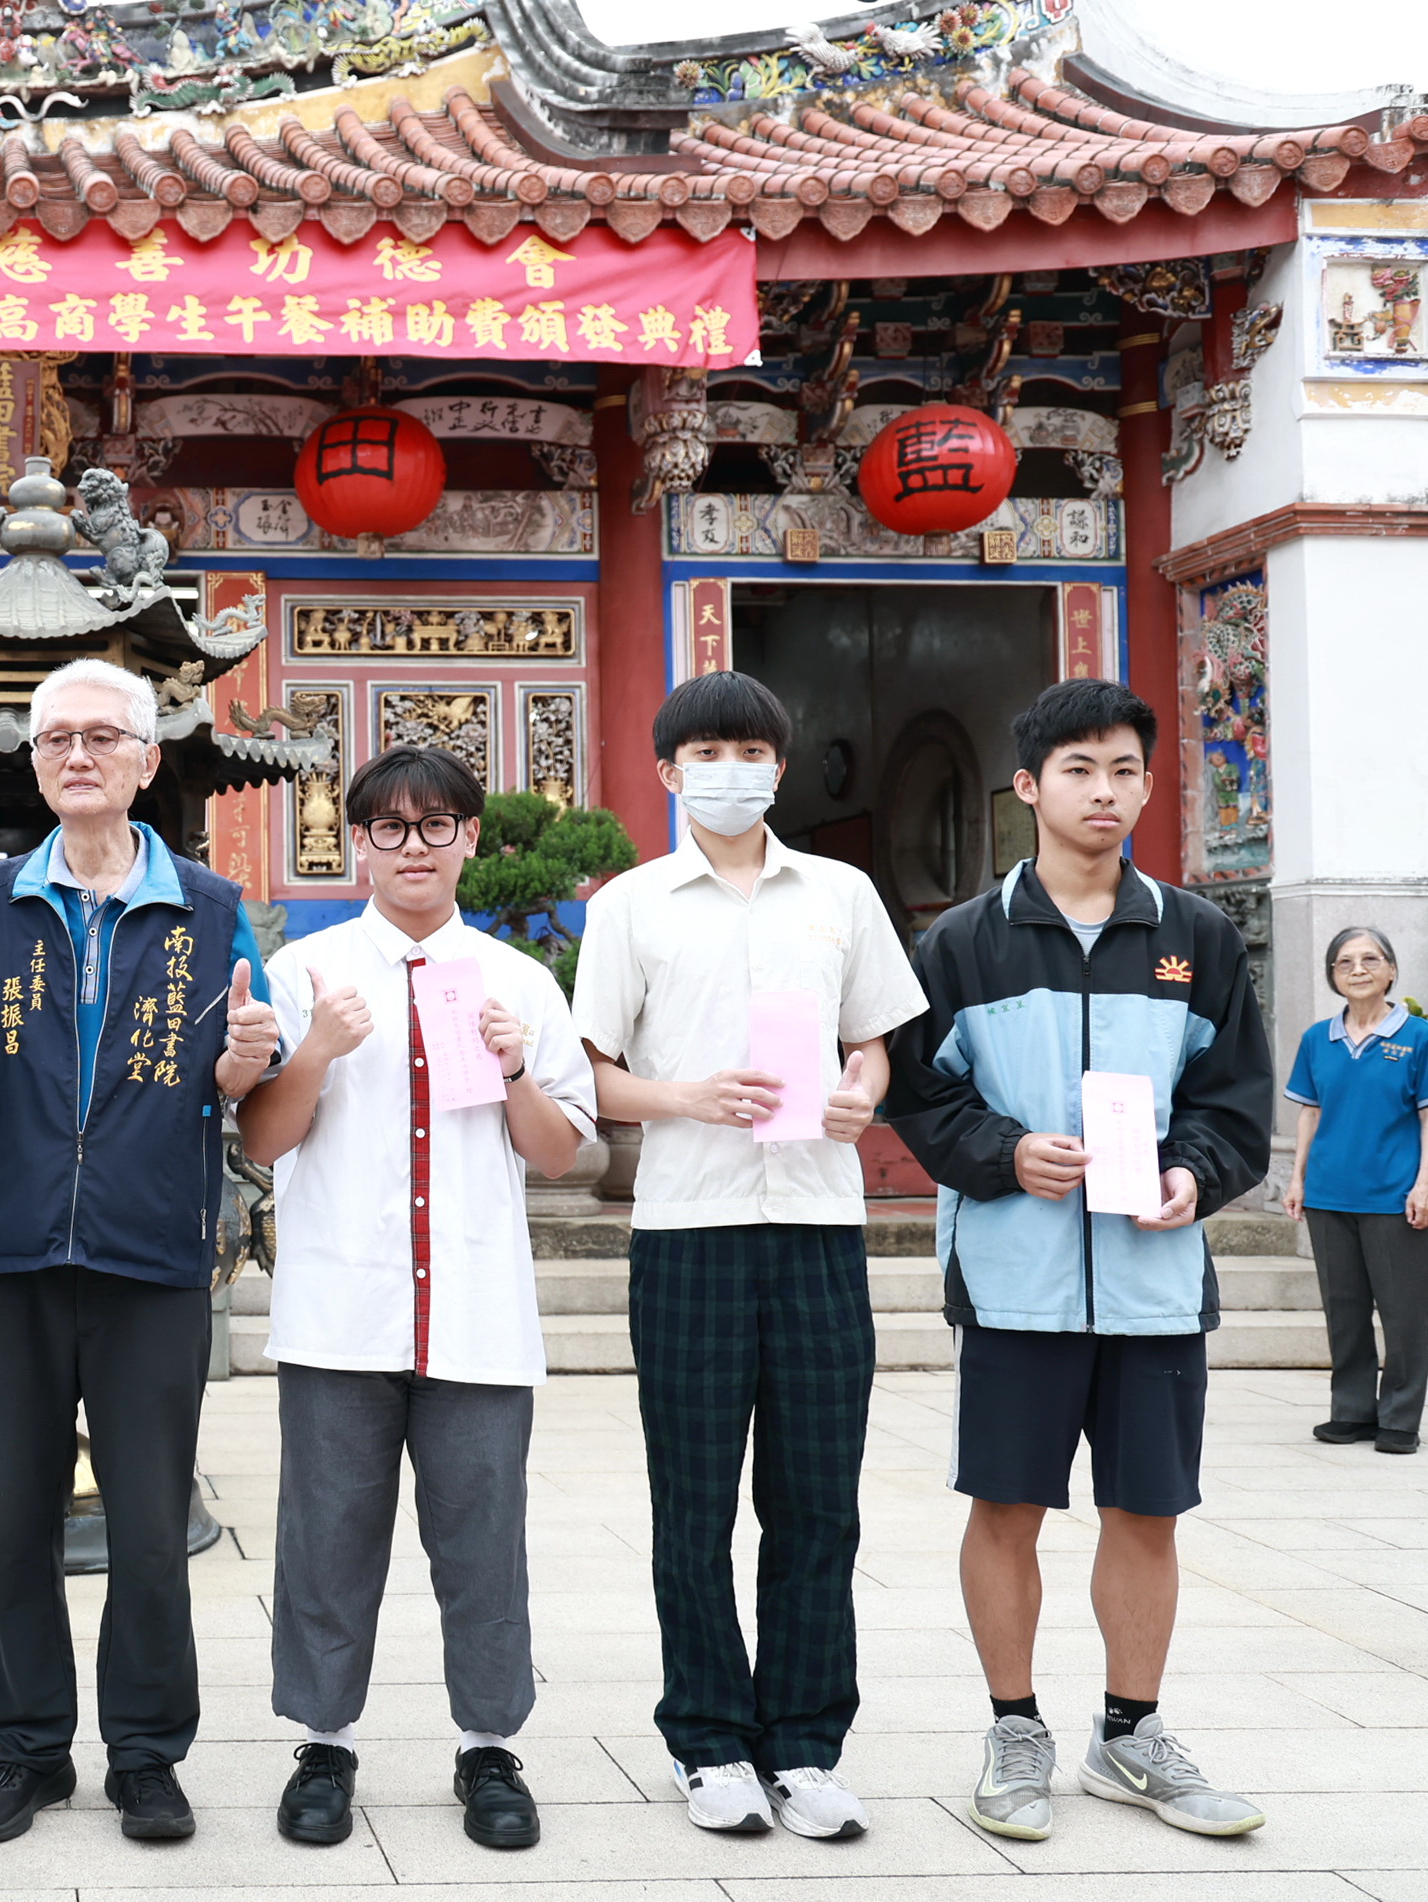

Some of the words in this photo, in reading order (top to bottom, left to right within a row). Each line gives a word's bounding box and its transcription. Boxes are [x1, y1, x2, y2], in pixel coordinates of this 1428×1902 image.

[316, 415, 399, 487] 田
[894, 416, 984, 502] 藍
[0, 977, 25, 1056] 張振昌
[29, 939, 47, 1012] 主任委員
[154, 925, 194, 1087] 南投藍田書院
[126, 995, 159, 1082] 濟化堂
